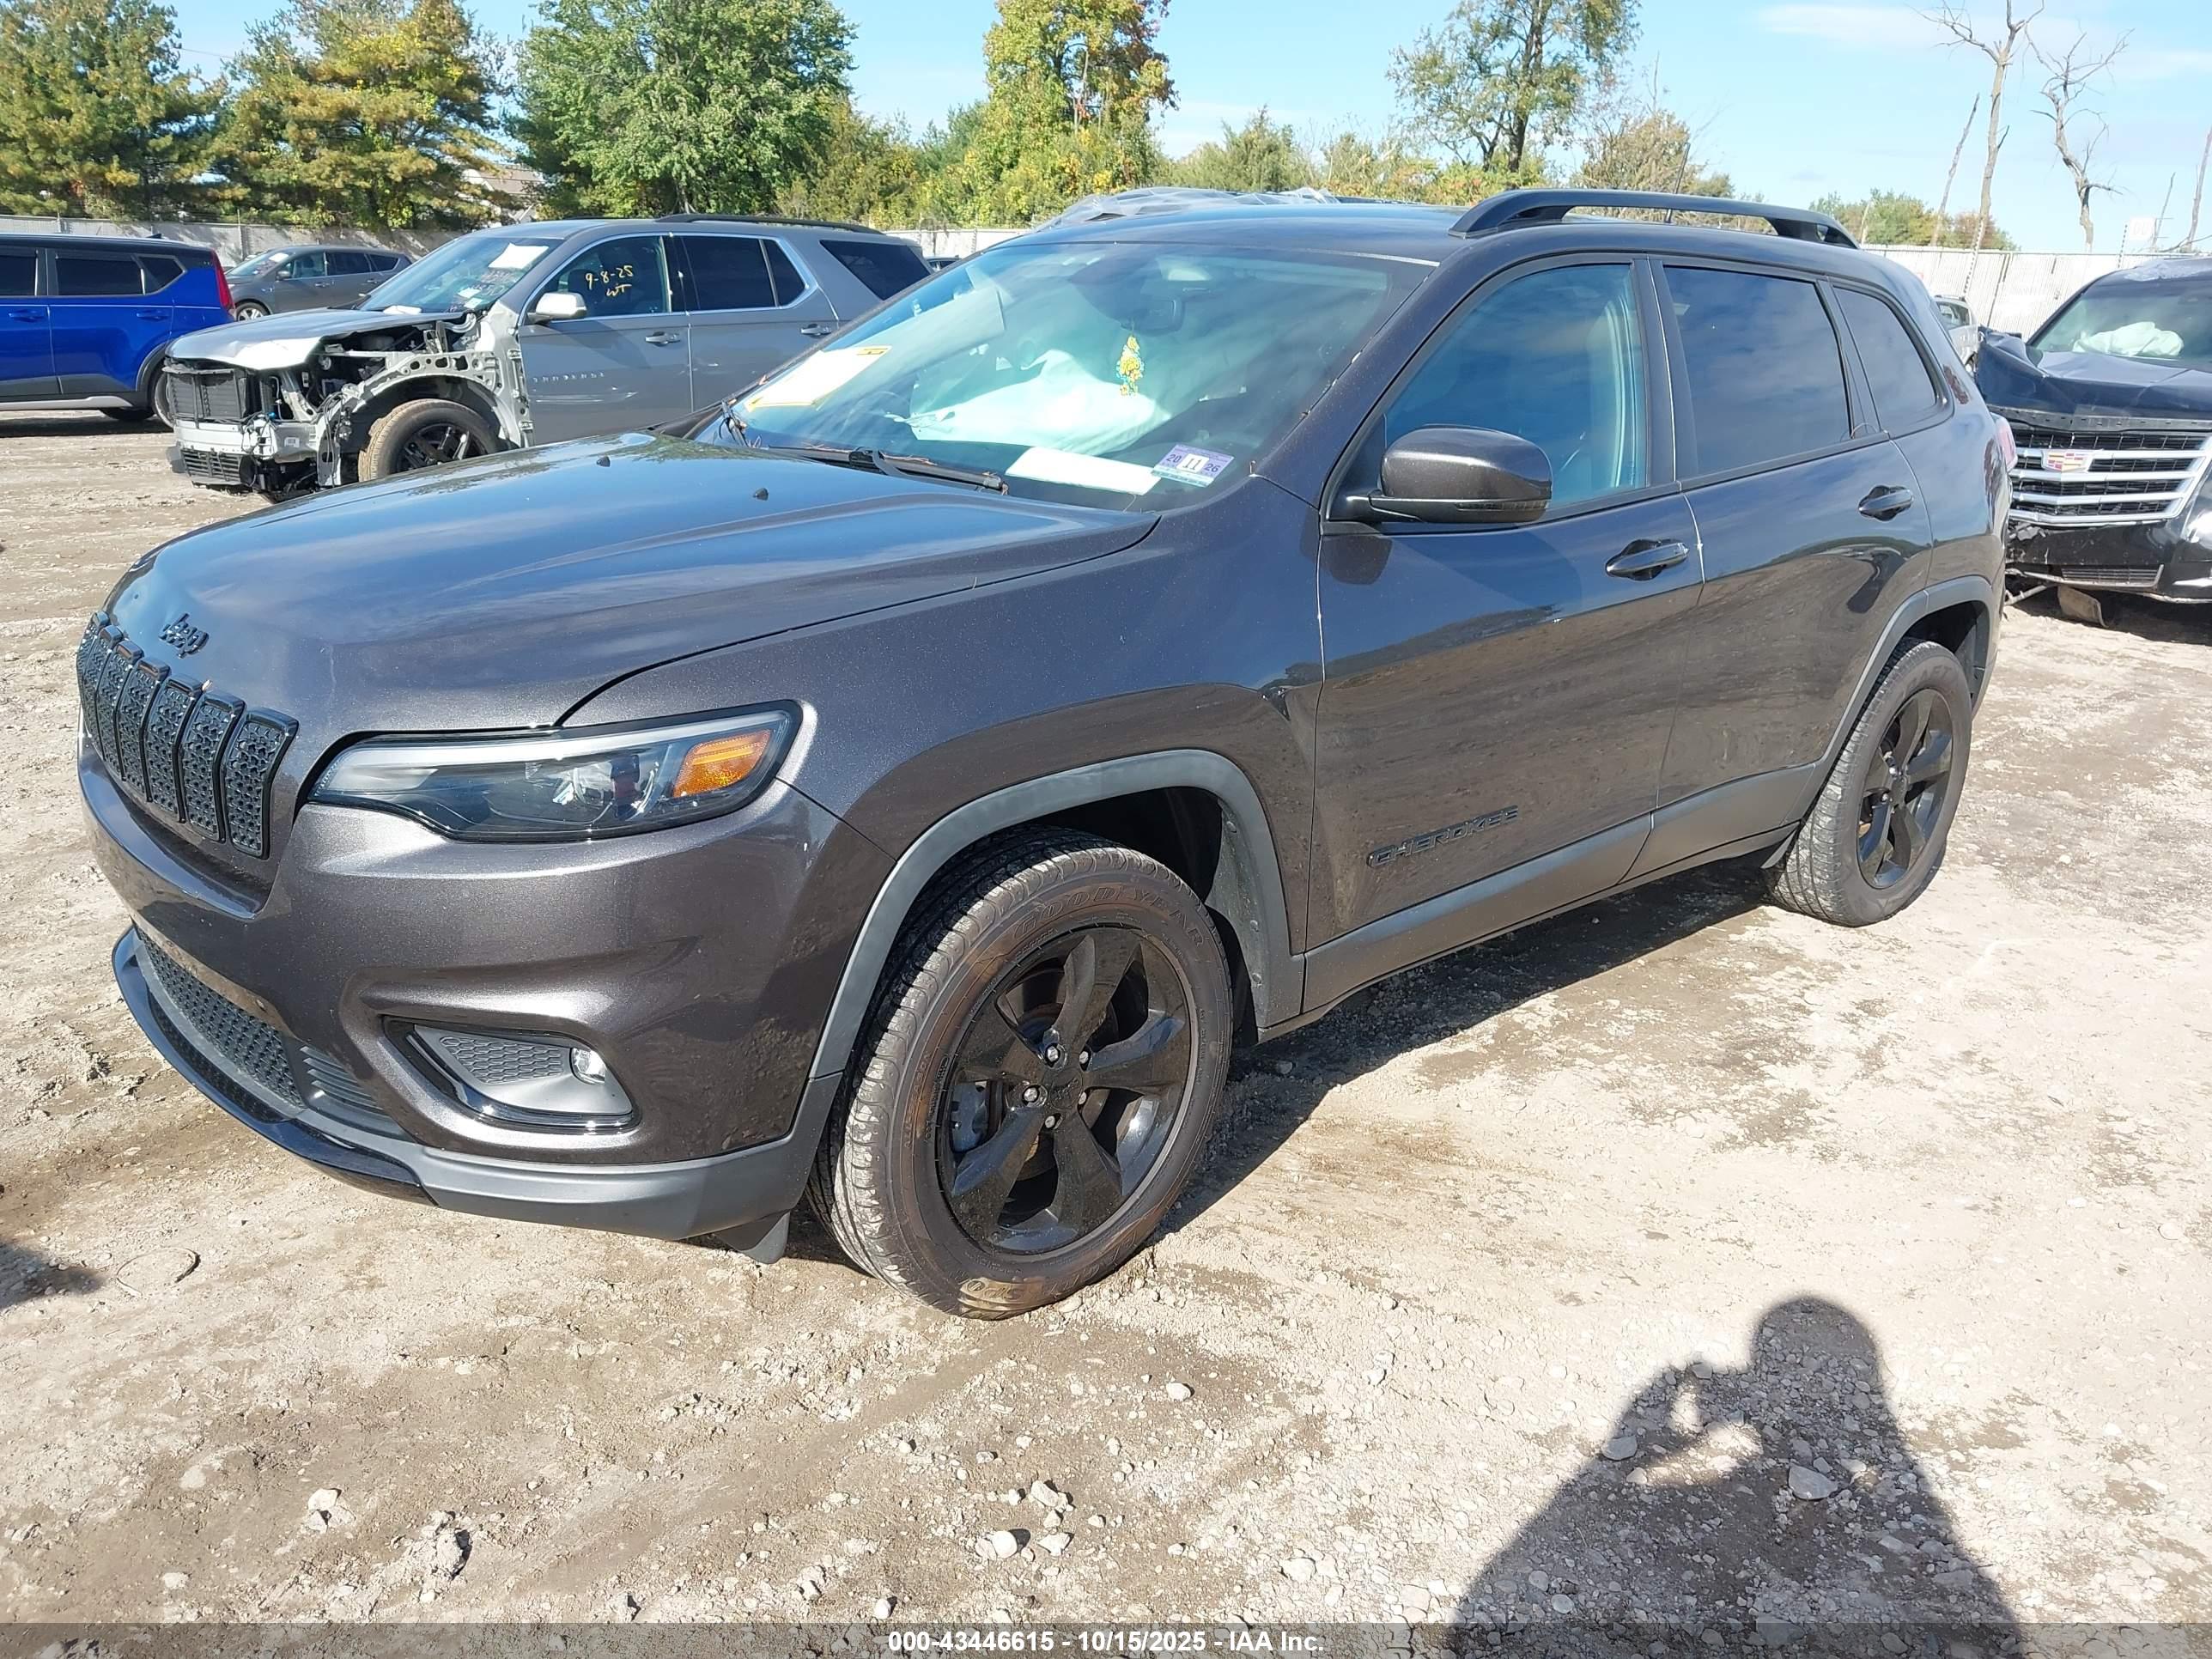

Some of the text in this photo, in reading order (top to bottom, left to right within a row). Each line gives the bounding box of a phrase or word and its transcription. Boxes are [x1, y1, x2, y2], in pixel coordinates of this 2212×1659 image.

[585, 264, 634, 290] 9-8-25
[1166, 453, 1221, 472] 20 11 26
[157, 612, 210, 659] Jeep
[1366, 805, 1519, 867] CHEROKEE
[1014, 885, 1204, 947] GOODYEAR
